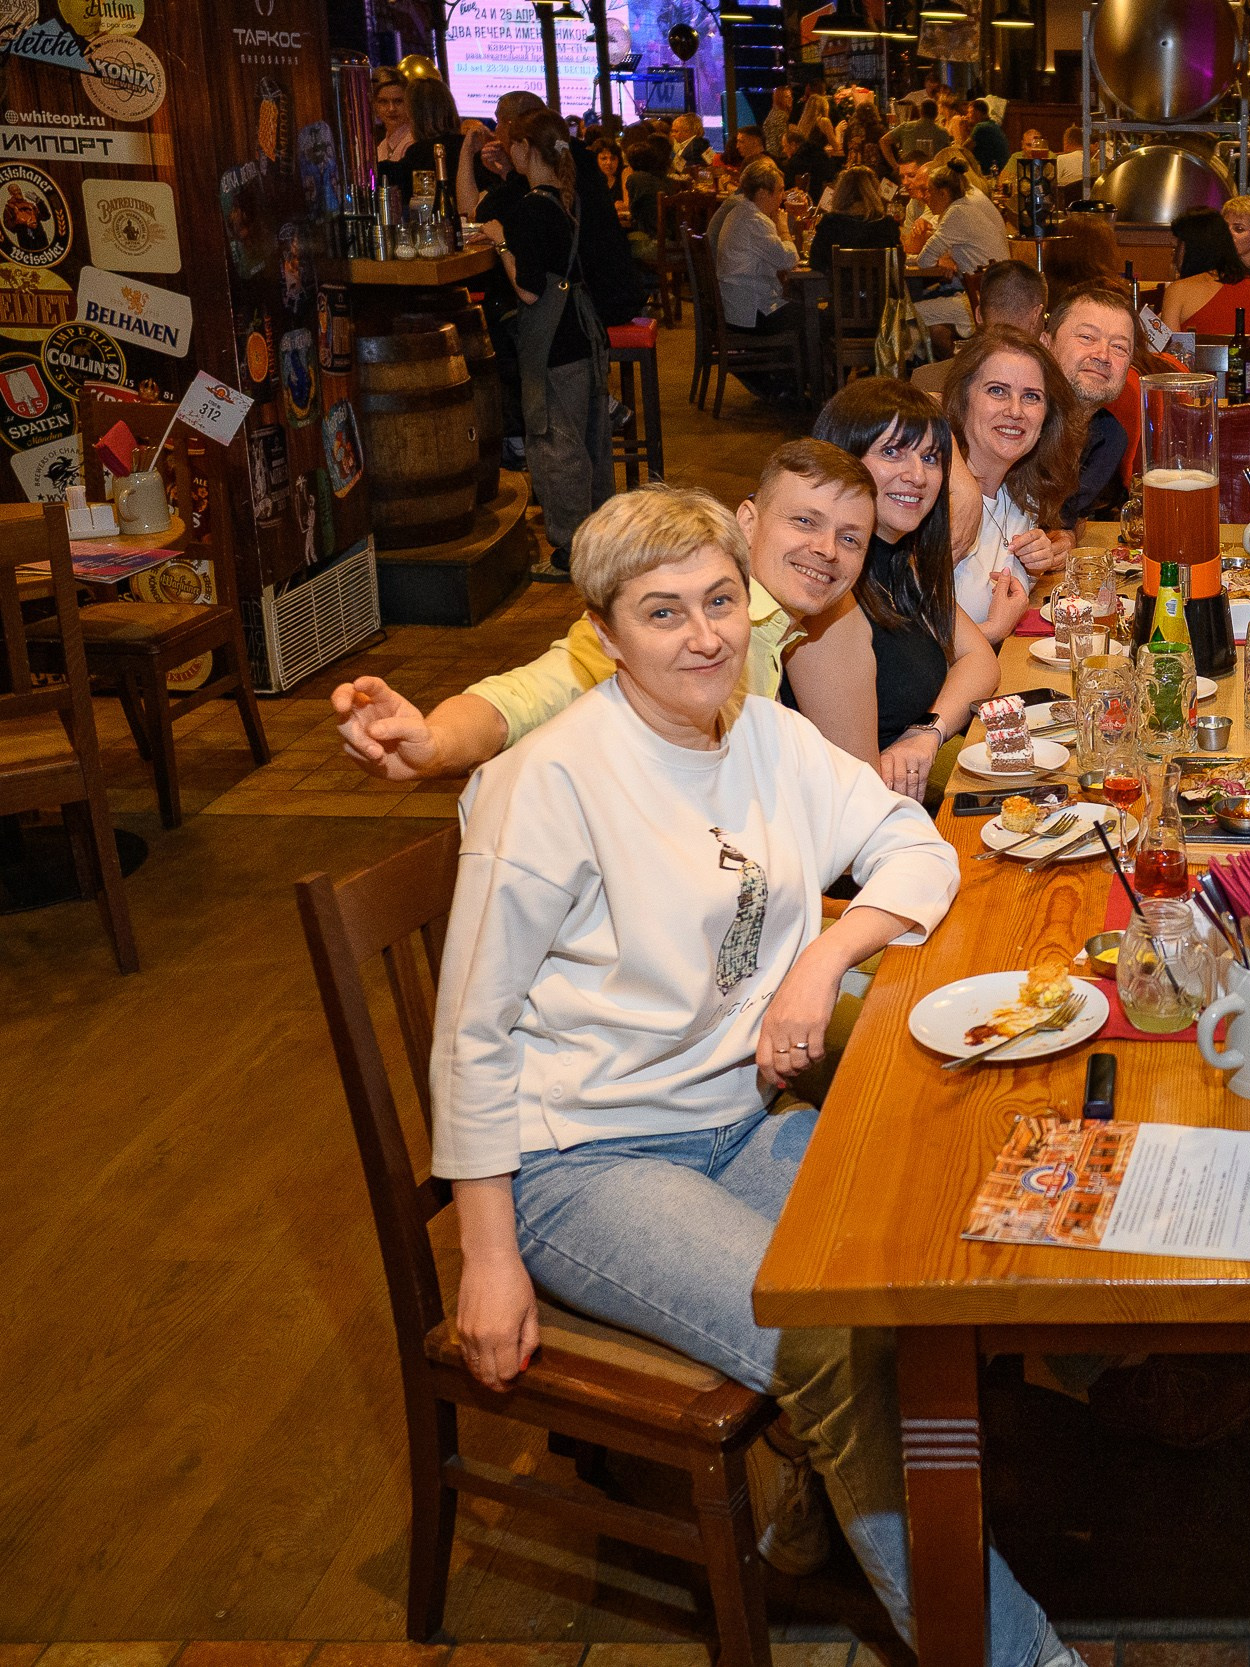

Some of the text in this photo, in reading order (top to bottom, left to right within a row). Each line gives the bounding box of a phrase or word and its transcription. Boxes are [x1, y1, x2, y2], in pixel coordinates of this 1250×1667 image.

[82, 0, 136, 20] Anton
[474, 8, 487, 20] 24
[490, 9, 497, 20] И
[500, 9, 513, 20] 25
[232, 28, 302, 48] ТАРКОС
[451, 26, 472, 39] ДВА
[474, 26, 513, 39] ВЕЧЕРА
[95, 59, 155, 93] KONIX
[19, 110, 106, 127] whiteopt.ru
[2, 132, 113, 156] ИМПОРТ
[0, 166, 53, 193] ziskaner
[10, 241, 65, 266] Weissbier
[0, 294, 70, 324] ELVET
[85, 300, 180, 348] BELHAVEN
[52, 326, 119, 361] IMPERIAL
[46, 347, 121, 381] COLLIN'S
[162, 391, 175, 401] 81
[199, 402, 222, 423] 312
[8, 413, 71, 440] SPATEN
